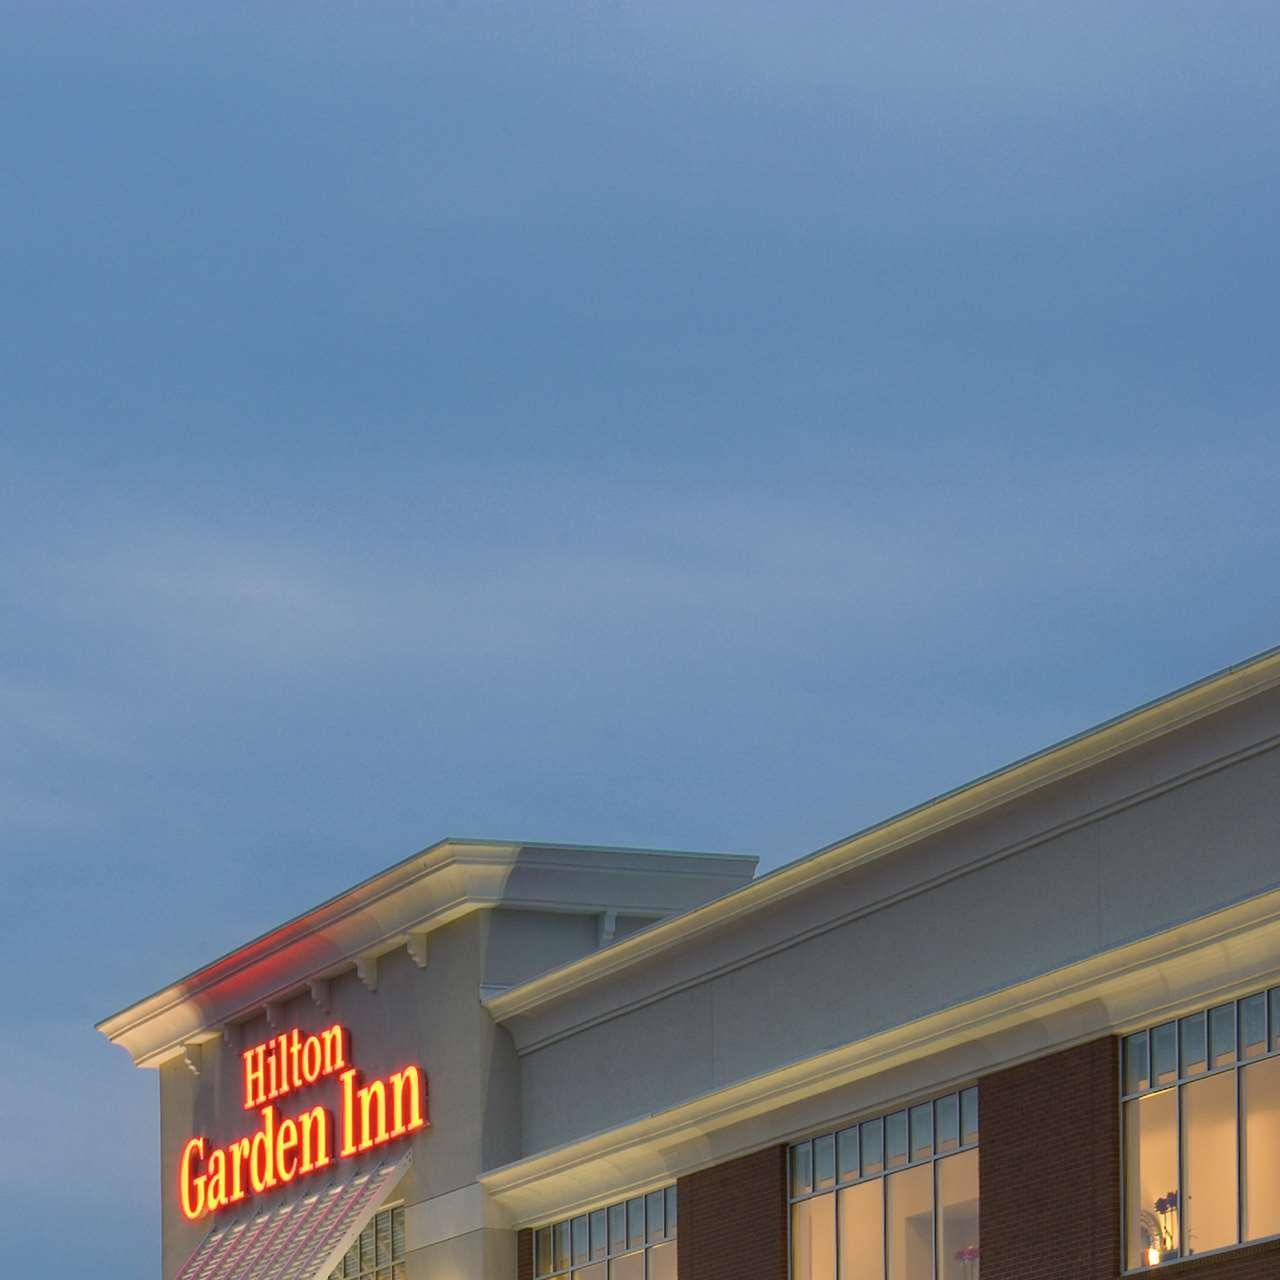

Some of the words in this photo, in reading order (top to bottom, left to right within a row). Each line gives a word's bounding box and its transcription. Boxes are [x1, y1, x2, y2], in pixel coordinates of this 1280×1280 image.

[242, 1023, 346, 1110] Hilton
[180, 1104, 330, 1220] Garden
[339, 1064, 424, 1158] Inn
